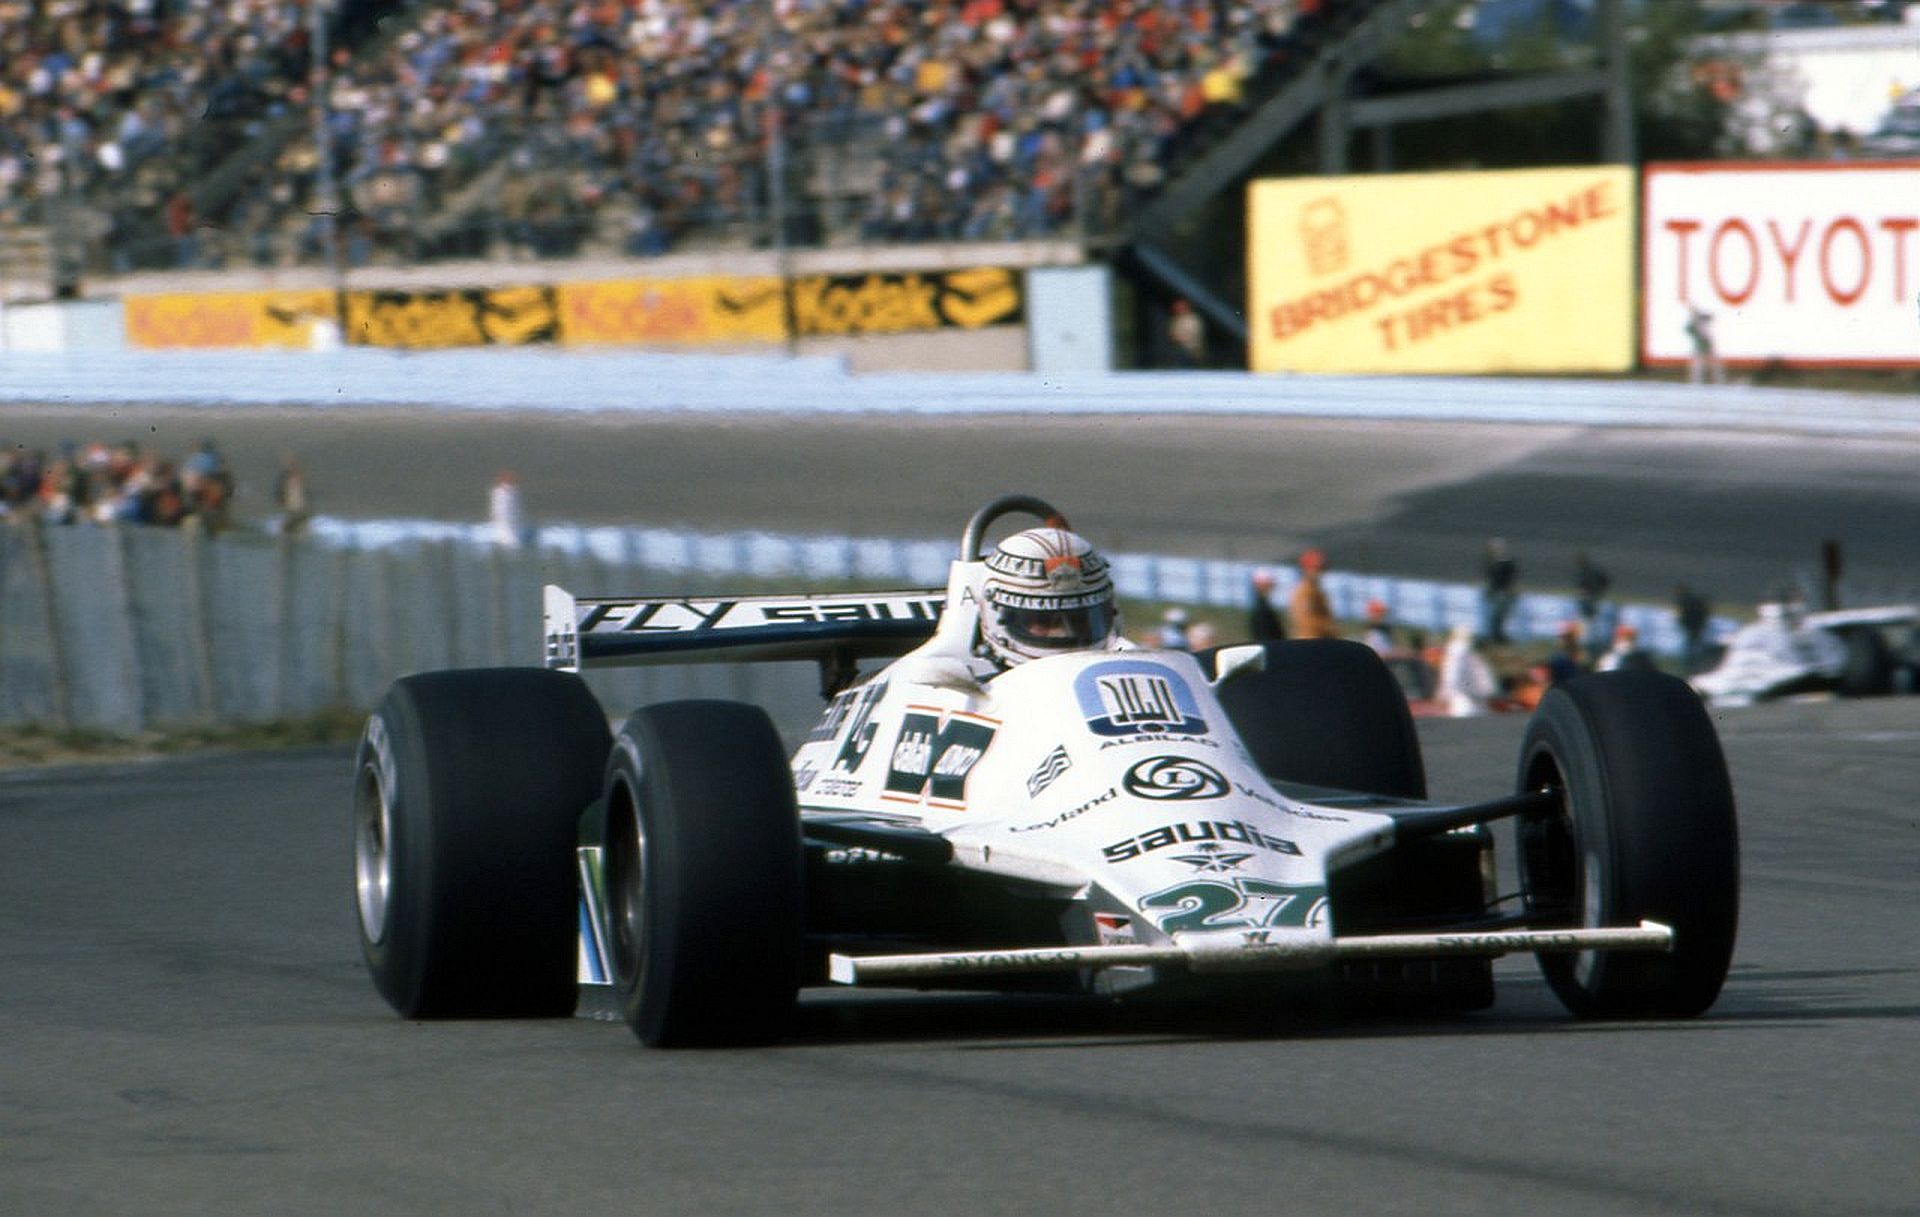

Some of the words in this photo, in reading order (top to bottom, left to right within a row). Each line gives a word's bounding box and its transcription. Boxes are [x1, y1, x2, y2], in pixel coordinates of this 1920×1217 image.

[1270, 180, 1616, 341] BRIDGESTONE
[794, 274, 940, 334] Kodak
[1376, 274, 1517, 350] TIRES
[579, 601, 737, 632] FLY
[762, 599, 946, 623] sau
[1099, 735, 1219, 750] ALBILAD
[1008, 787, 1118, 832] Leyland
[1102, 820, 1304, 863] saudia
